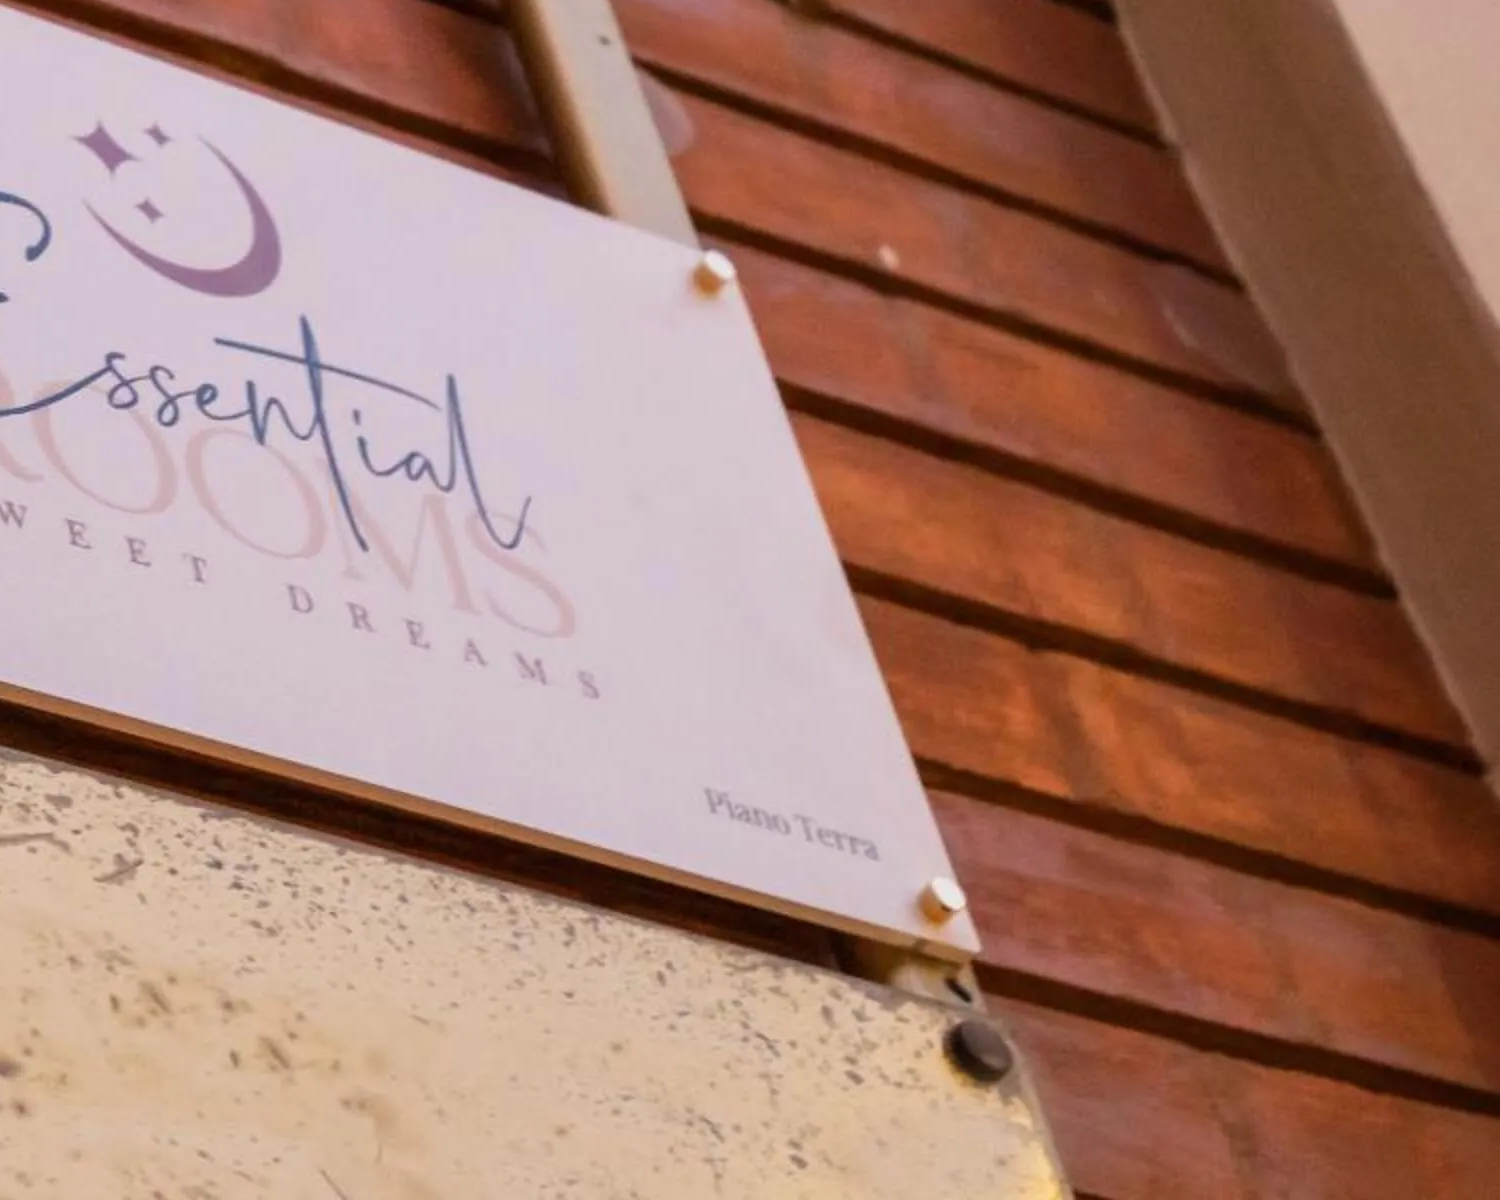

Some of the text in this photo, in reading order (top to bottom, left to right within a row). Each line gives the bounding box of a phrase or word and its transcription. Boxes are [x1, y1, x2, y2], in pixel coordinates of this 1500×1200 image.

[286, 583, 600, 700] DREAMS
[703, 785, 882, 862] Piano Terra
